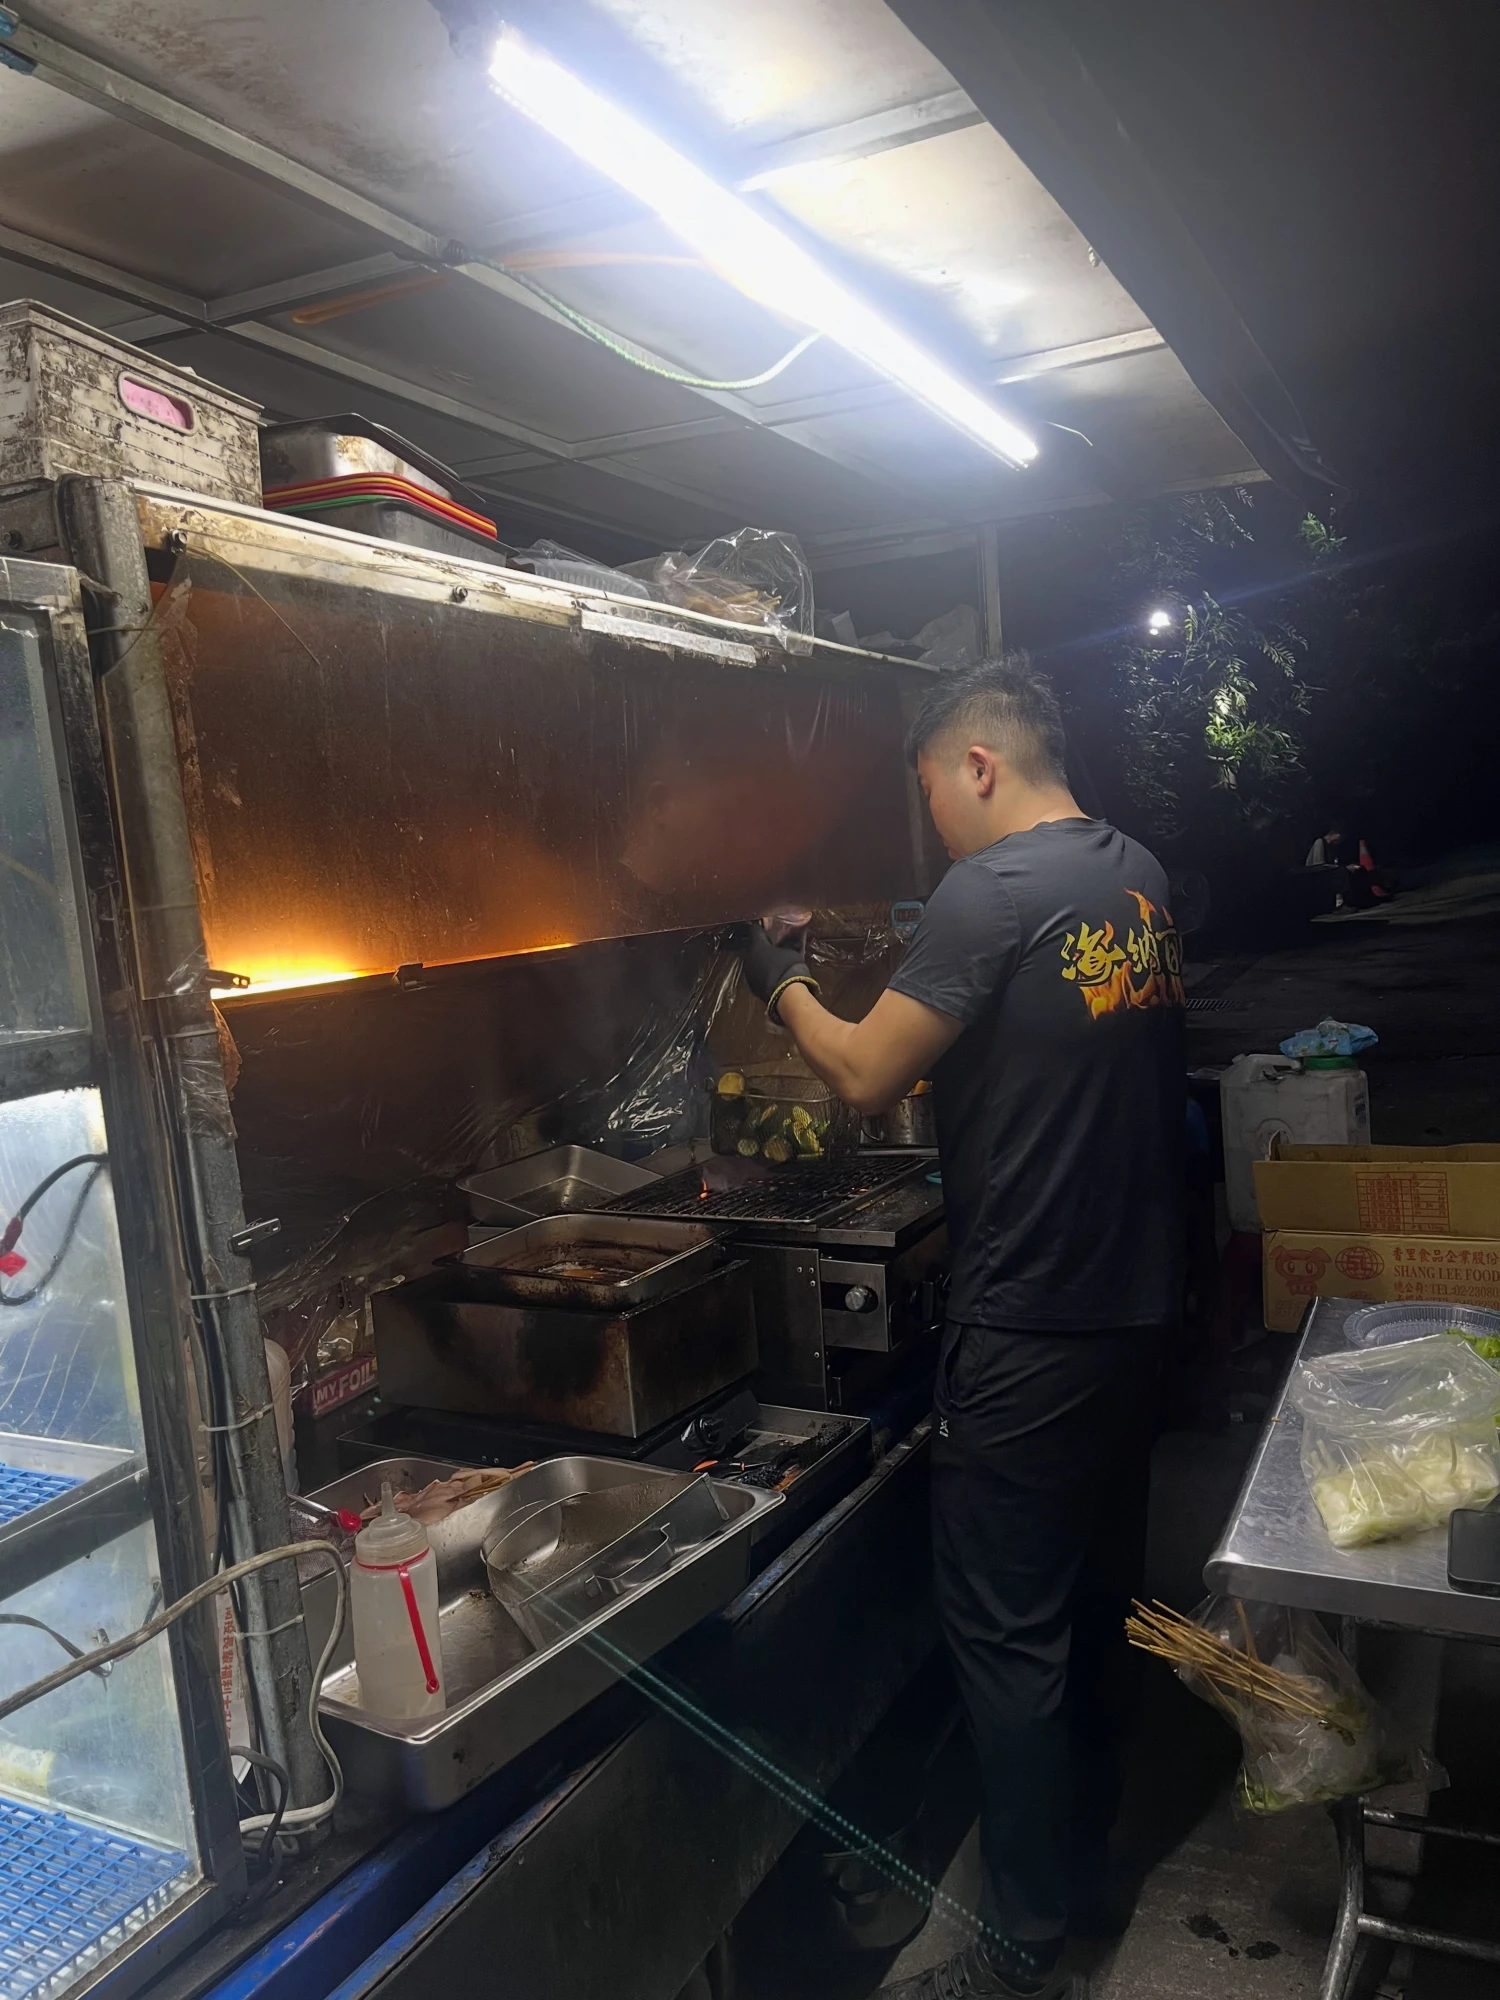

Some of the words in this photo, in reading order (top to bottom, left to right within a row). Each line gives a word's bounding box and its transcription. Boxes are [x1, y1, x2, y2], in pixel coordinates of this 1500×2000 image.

[1061, 921, 1183, 985] 海納百
[1394, 1265, 1435, 1279] SHANG
[1438, 1267, 1462, 1281] LEE
[316, 1381, 338, 1401] MY
[339, 1362, 375, 1398] FOIL
